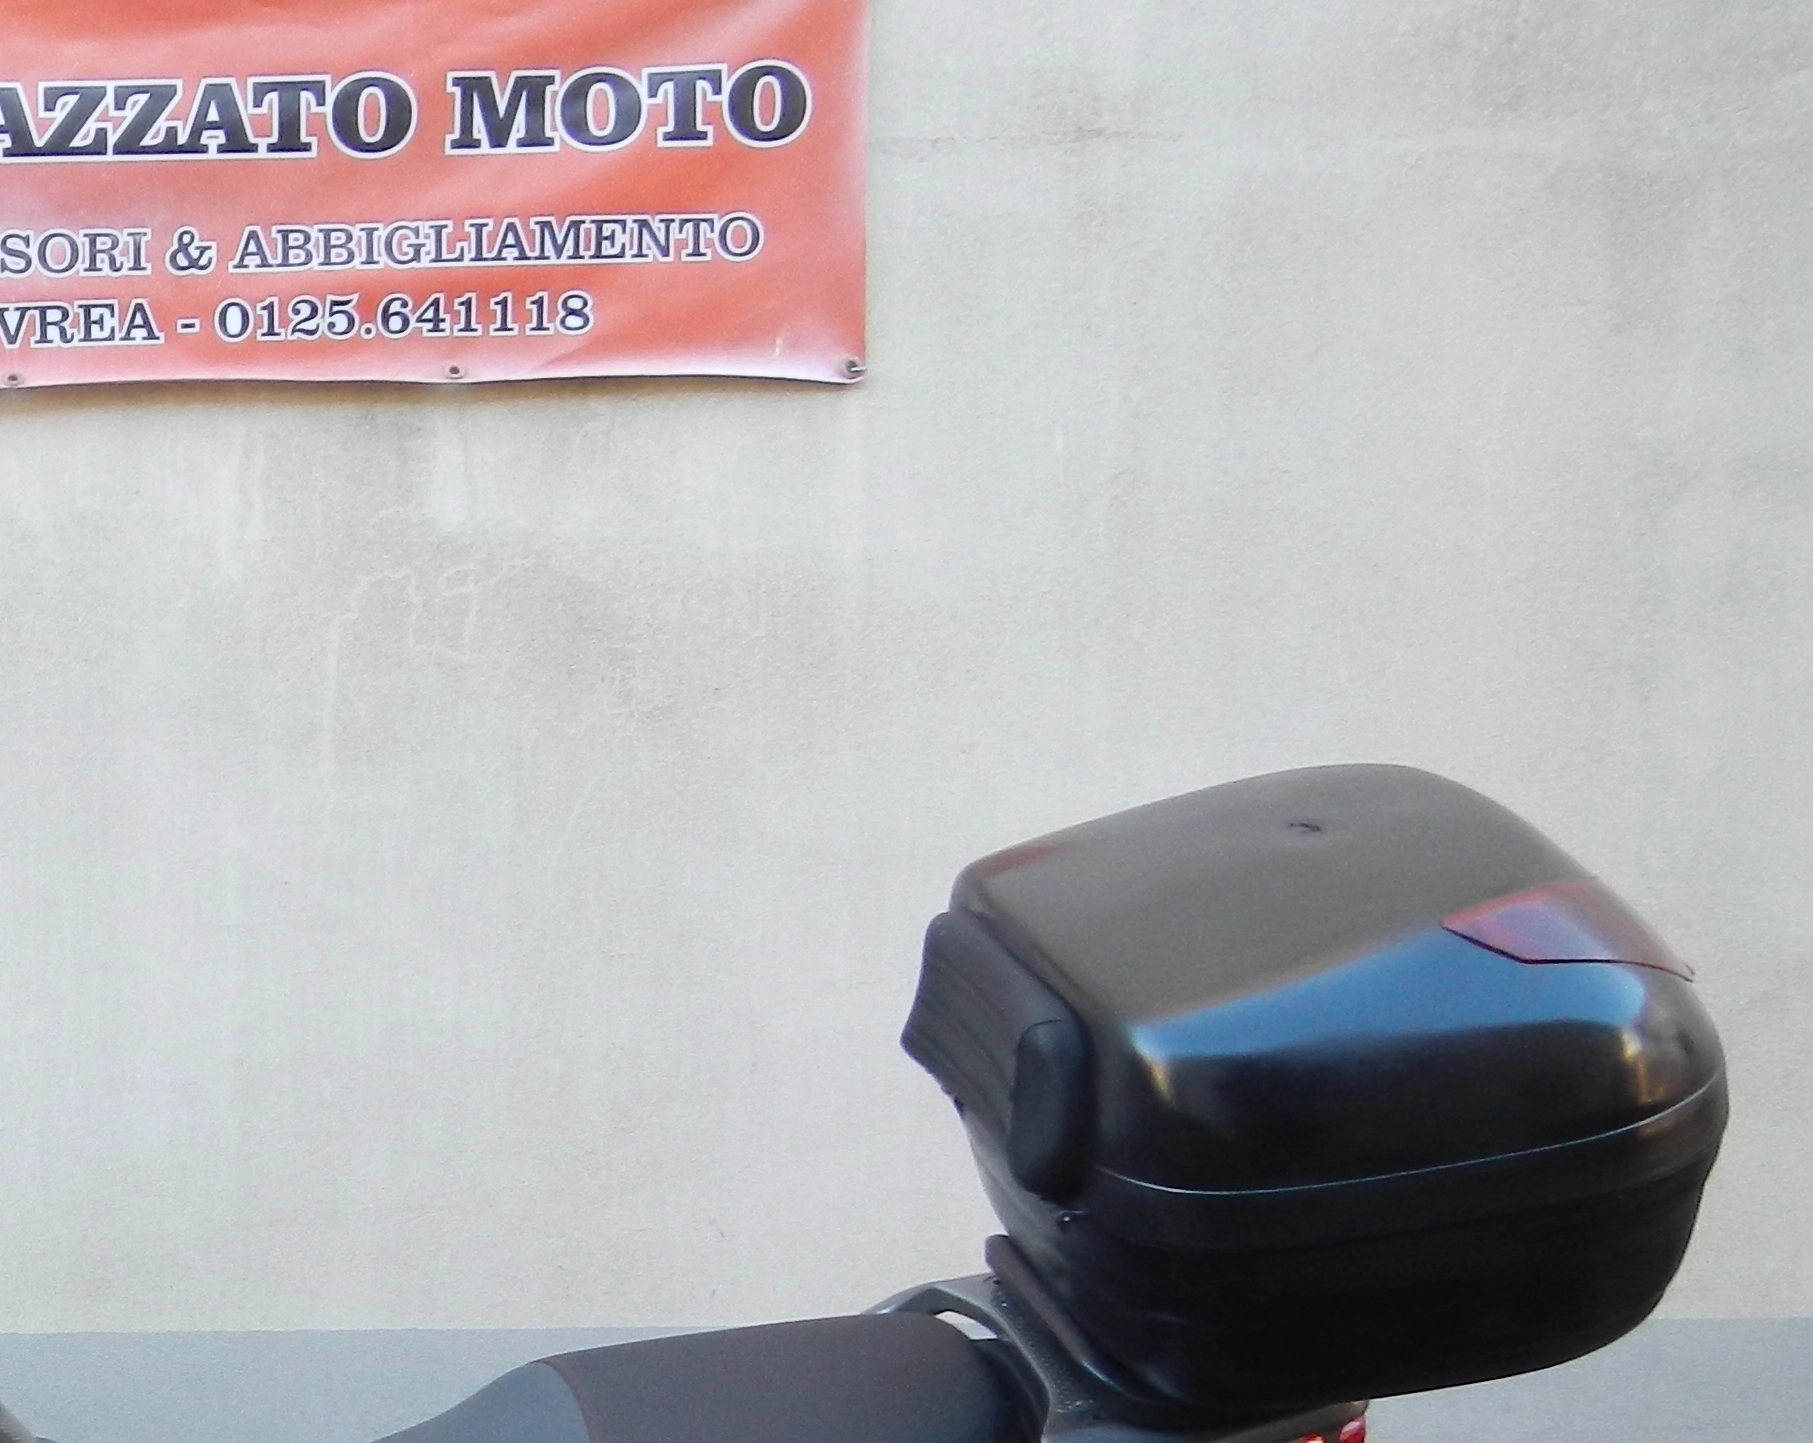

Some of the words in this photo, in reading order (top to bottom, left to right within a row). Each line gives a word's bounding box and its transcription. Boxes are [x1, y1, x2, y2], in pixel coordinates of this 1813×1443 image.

[446, 58, 811, 155] MOTO
[167, 228, 215, 275] &
[233, 213, 763, 273] ABBIGLIAMENTO
[213, 292, 592, 343] 0125.641118
